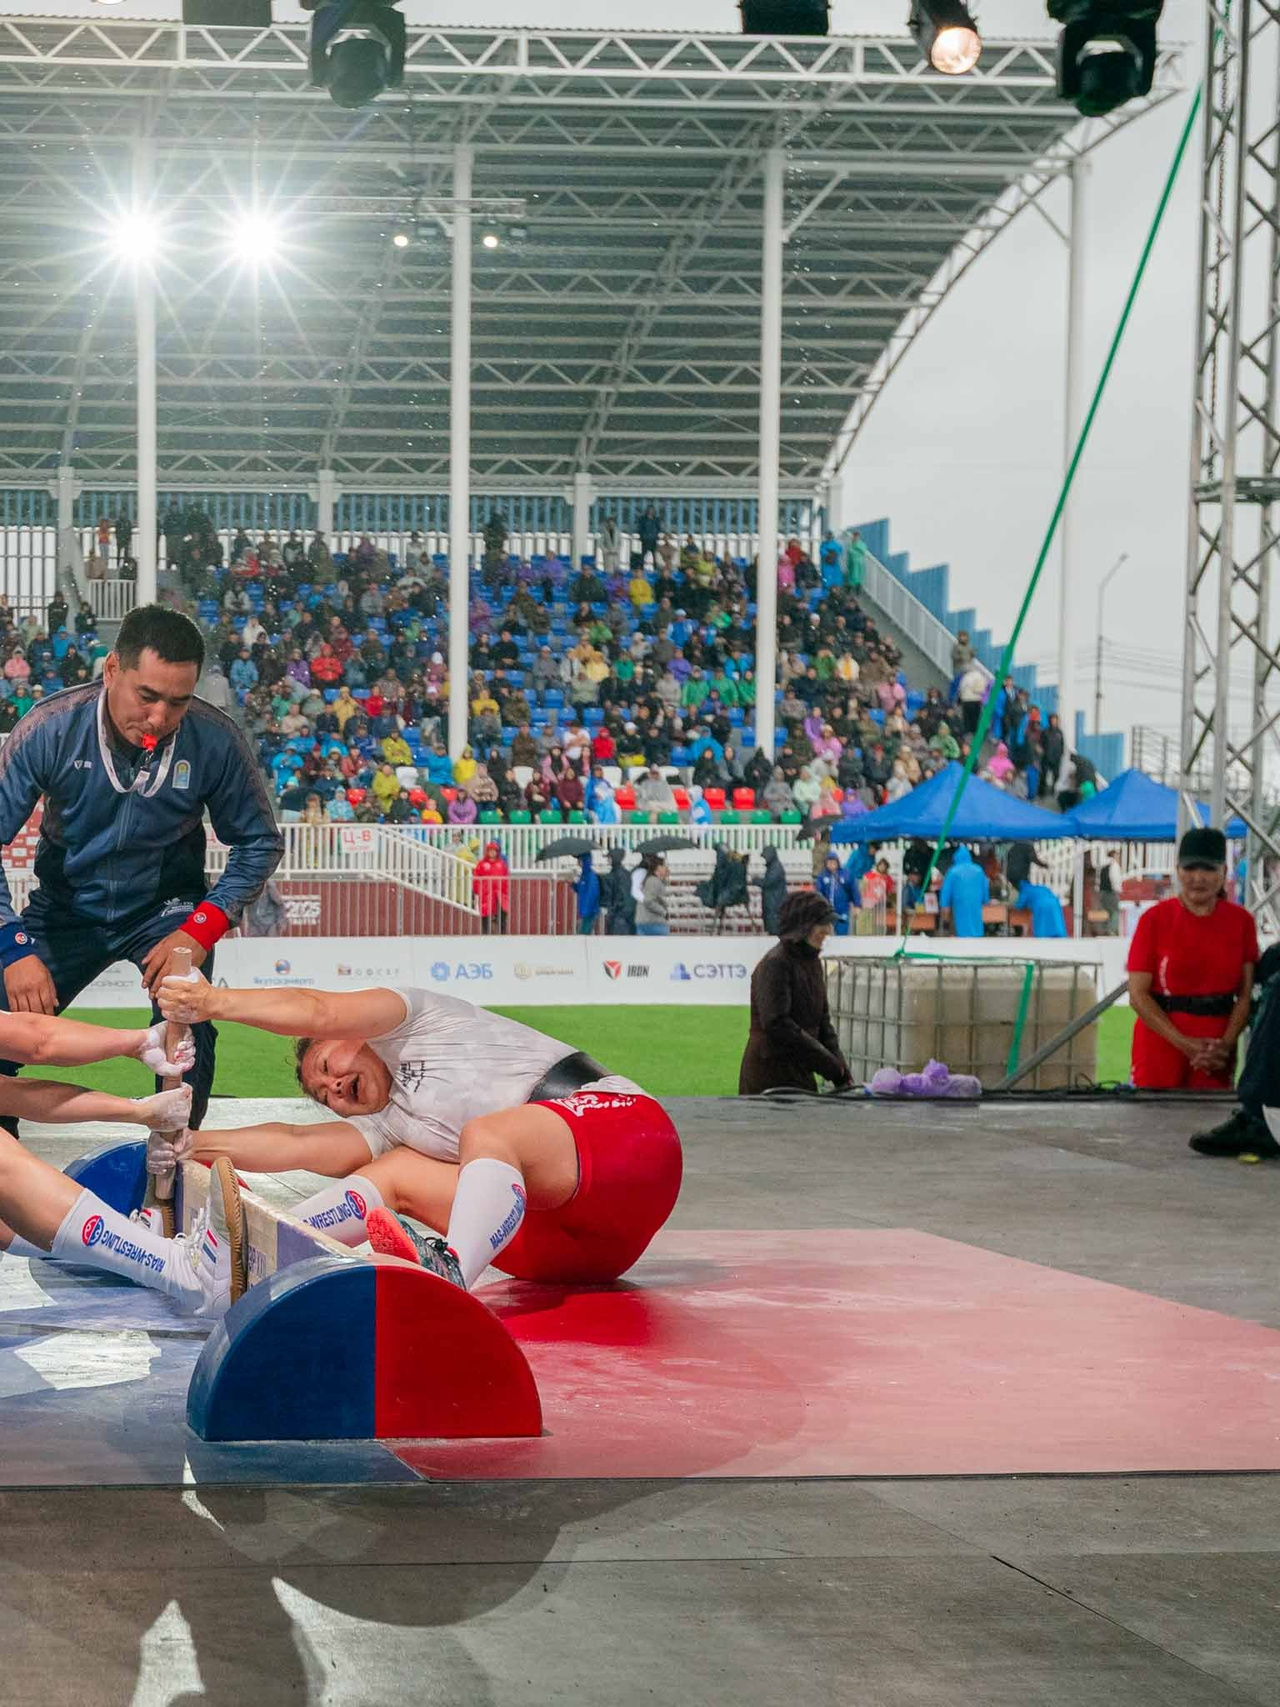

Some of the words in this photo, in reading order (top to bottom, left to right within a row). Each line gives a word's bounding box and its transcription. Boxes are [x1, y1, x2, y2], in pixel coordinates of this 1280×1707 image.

[455, 963, 494, 979] АЭБ
[626, 964, 650, 978] IRON
[693, 963, 748, 979] СЭТТЭ
[101, 1230, 166, 1273] MAS-WRESTLING
